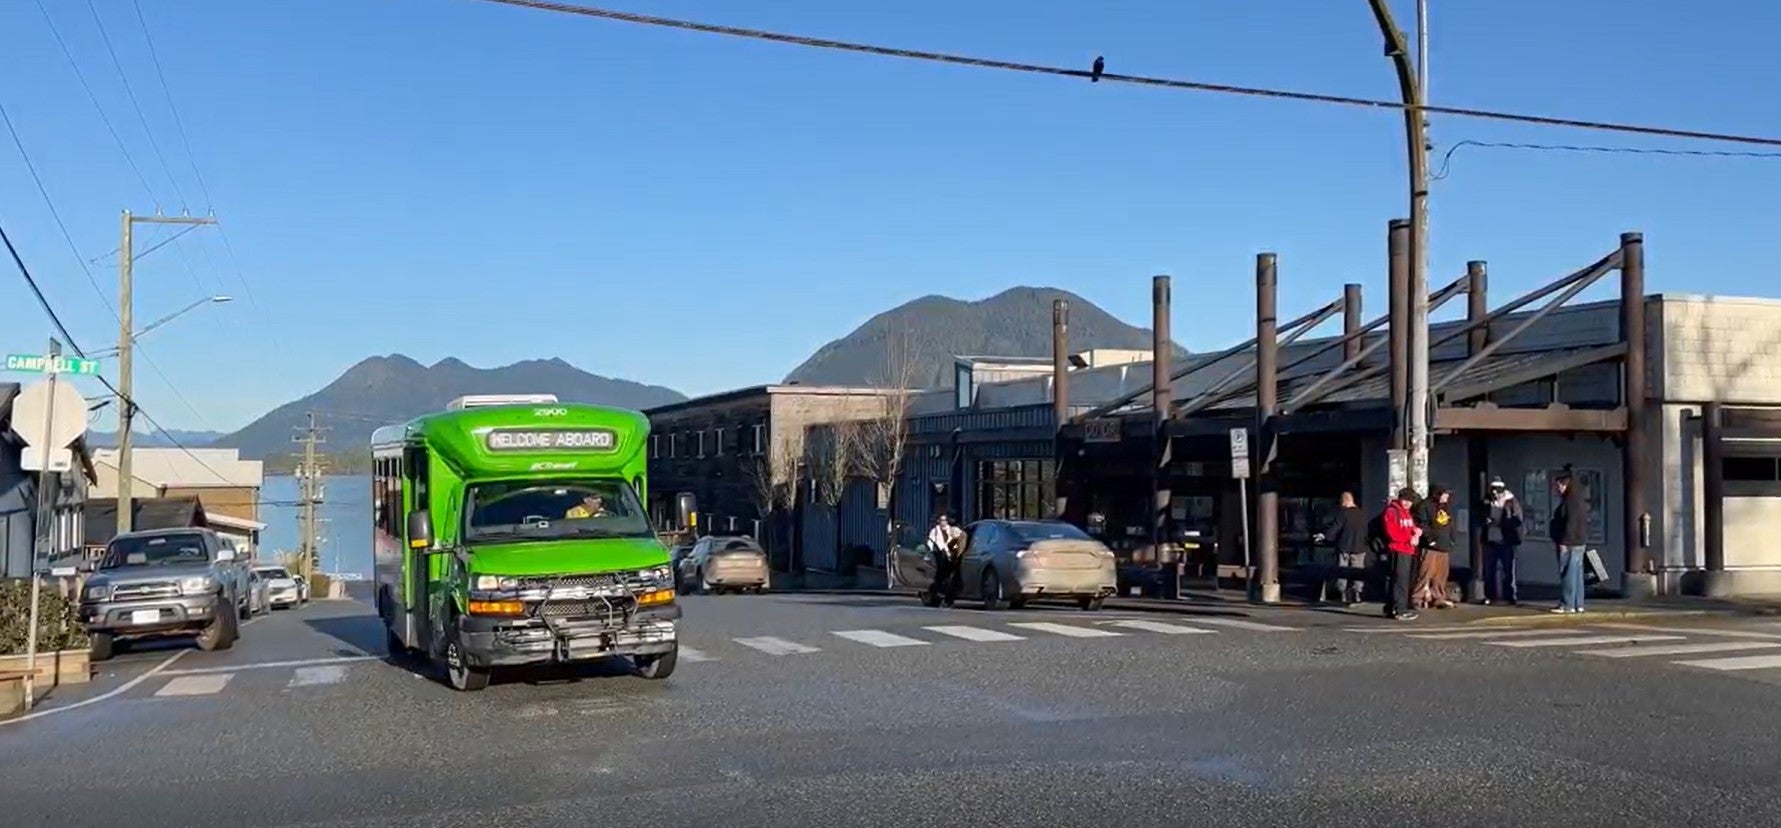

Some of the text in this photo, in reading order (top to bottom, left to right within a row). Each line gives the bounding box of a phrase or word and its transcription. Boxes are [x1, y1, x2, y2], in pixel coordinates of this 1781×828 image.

[80, 360, 97, 374] ST
[492, 432, 610, 447] WELCOME ABOARD
